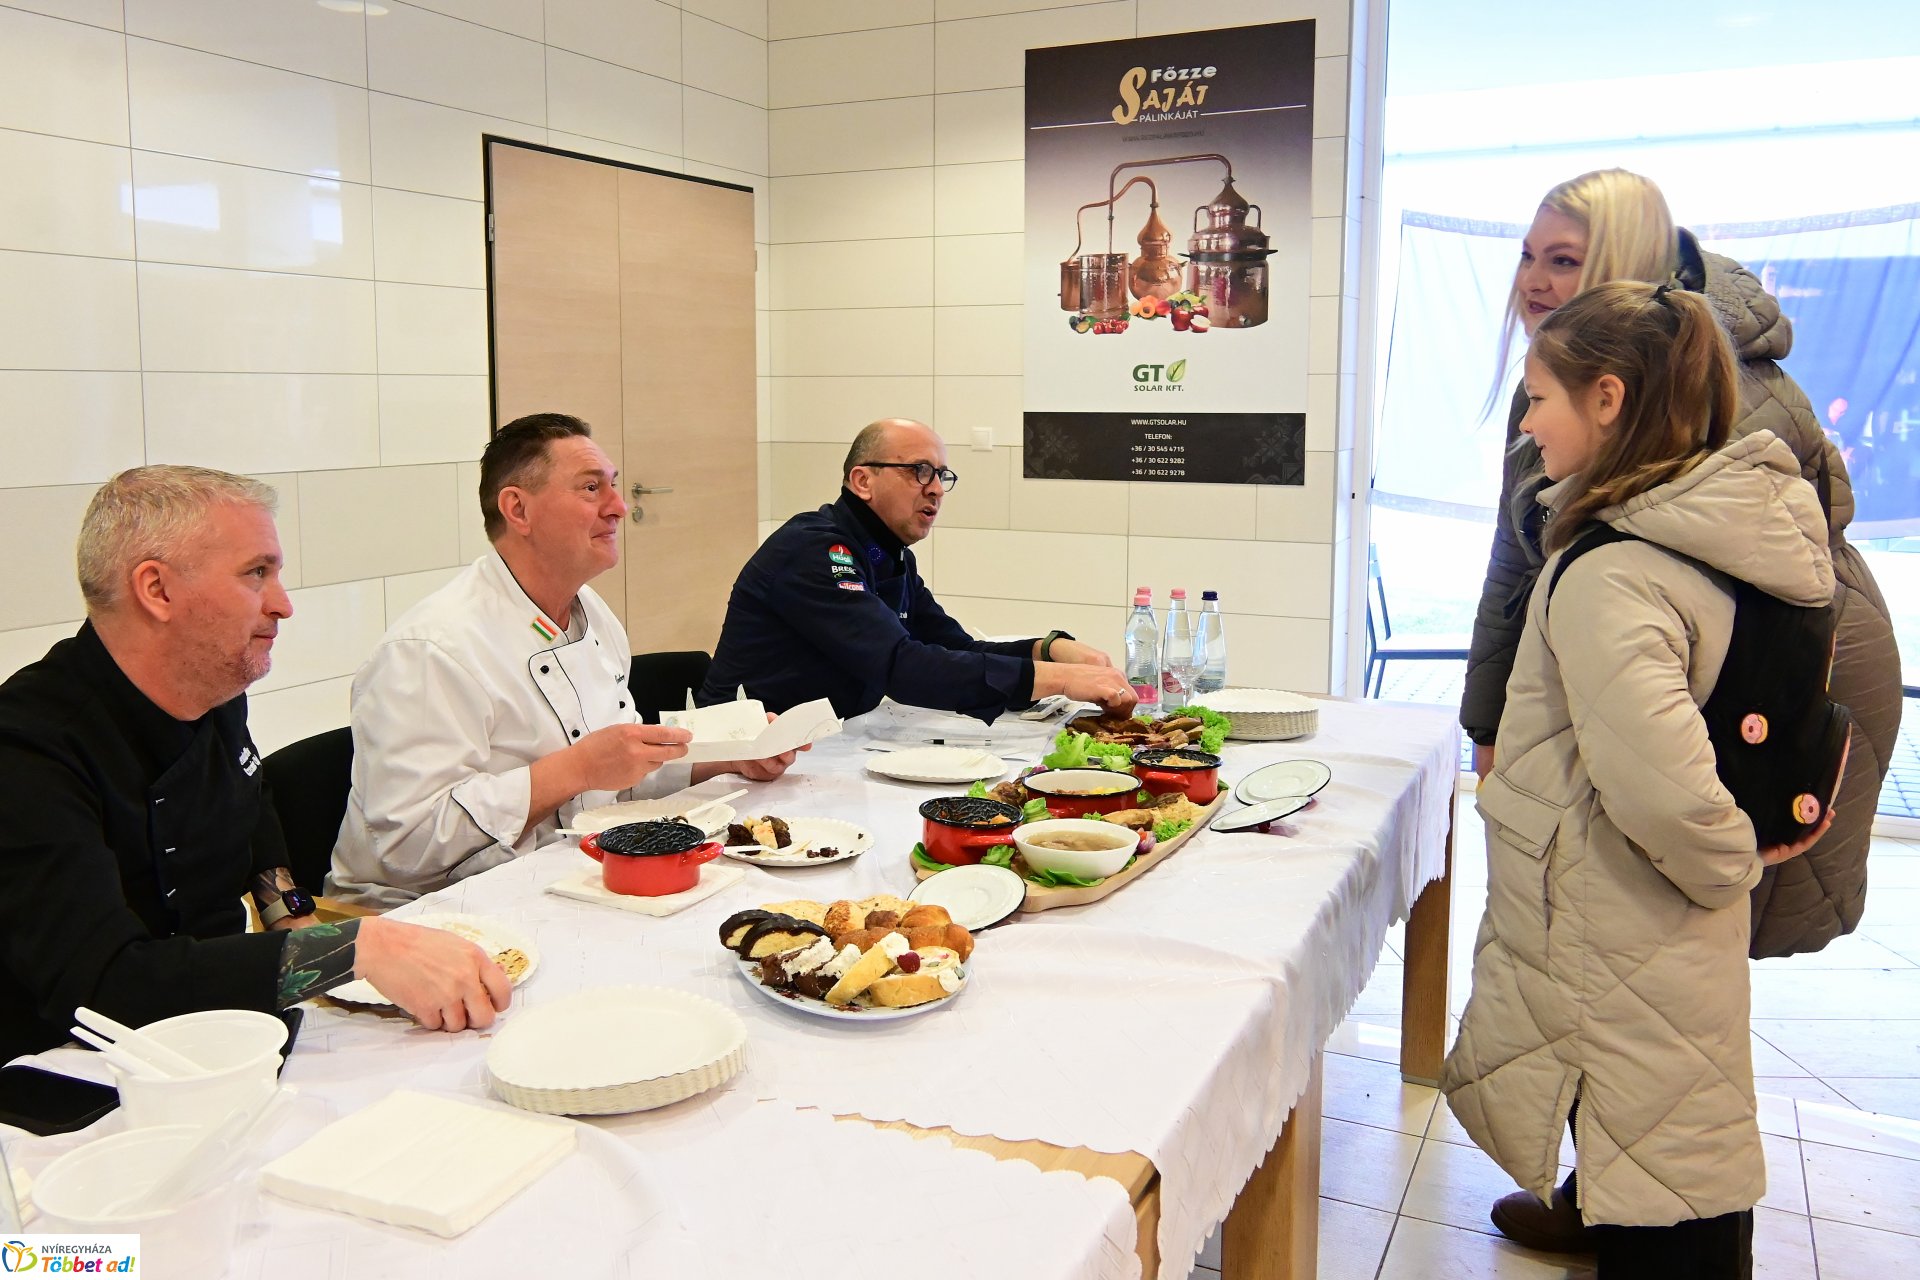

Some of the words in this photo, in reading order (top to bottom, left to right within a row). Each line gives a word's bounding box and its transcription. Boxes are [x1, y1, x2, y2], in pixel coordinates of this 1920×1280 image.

[1112, 66, 1209, 125] SAJÁT
[1139, 110, 1199, 123] PÁLINKÁJÁT
[1132, 364, 1165, 382] GT
[1169, 445, 1185, 453] 4715
